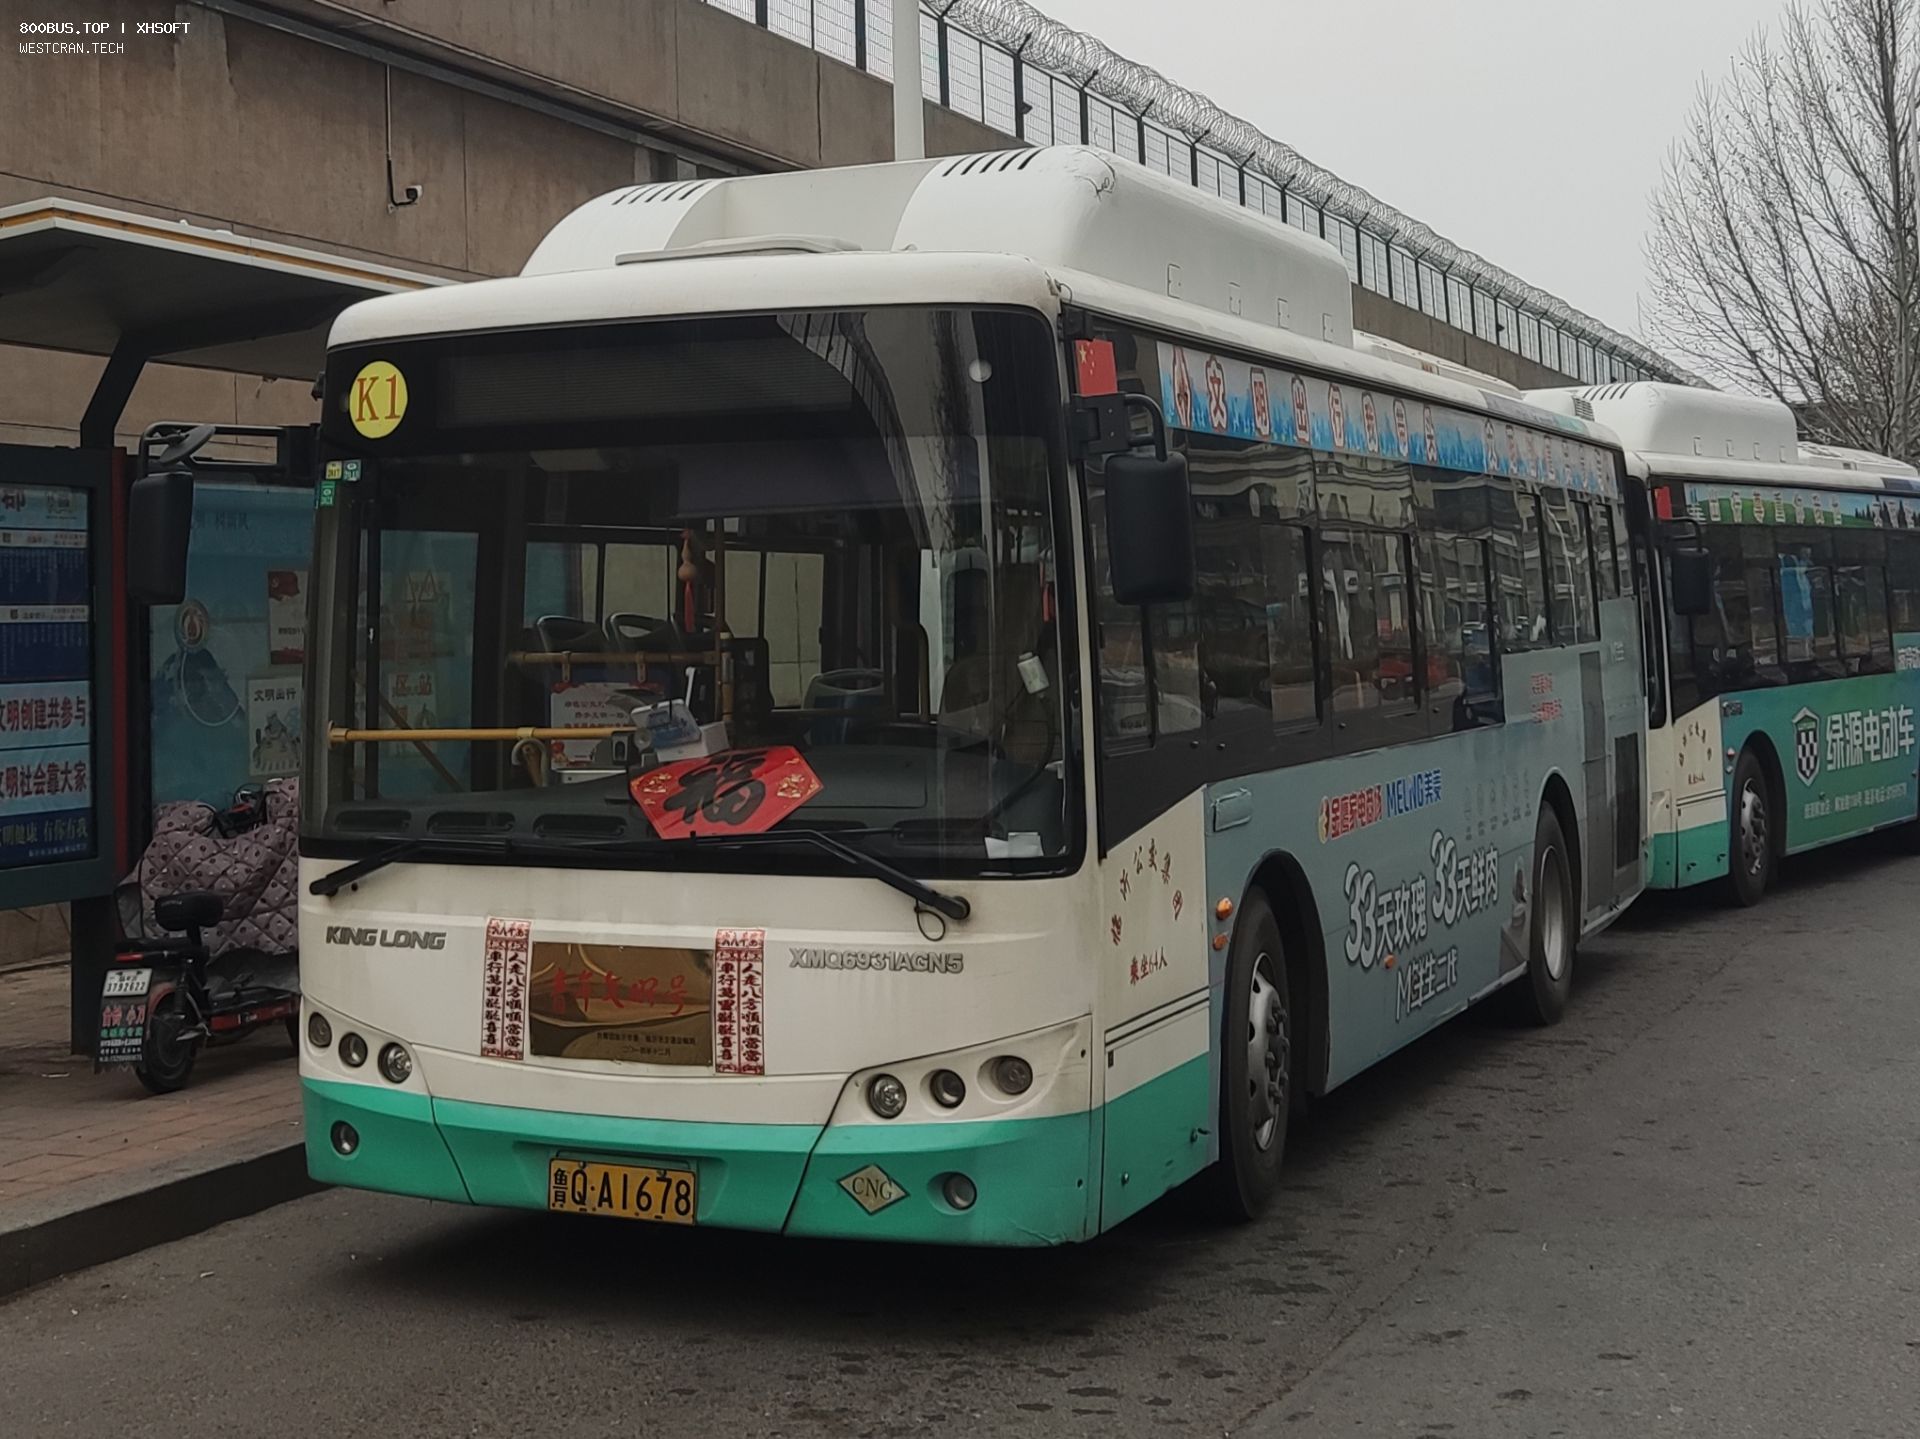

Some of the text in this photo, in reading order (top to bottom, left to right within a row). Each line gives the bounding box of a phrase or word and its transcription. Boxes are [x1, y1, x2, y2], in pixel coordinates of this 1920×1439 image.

[355, 373, 401, 422] K1
[254, 688, 297, 702] 文明出行
[1826, 704, 1914, 772] 绿源电动车
[663, 750, 768, 826] 福
[0, 822, 38, 846] 明健康
[1344, 829, 1499, 969] 33天玫瑰 33天鲜肉
[326, 926, 447, 950] KING LONG
[788, 948, 964, 974] XMQ6931AGN5
[852, 1176, 893, 1201] CNG
